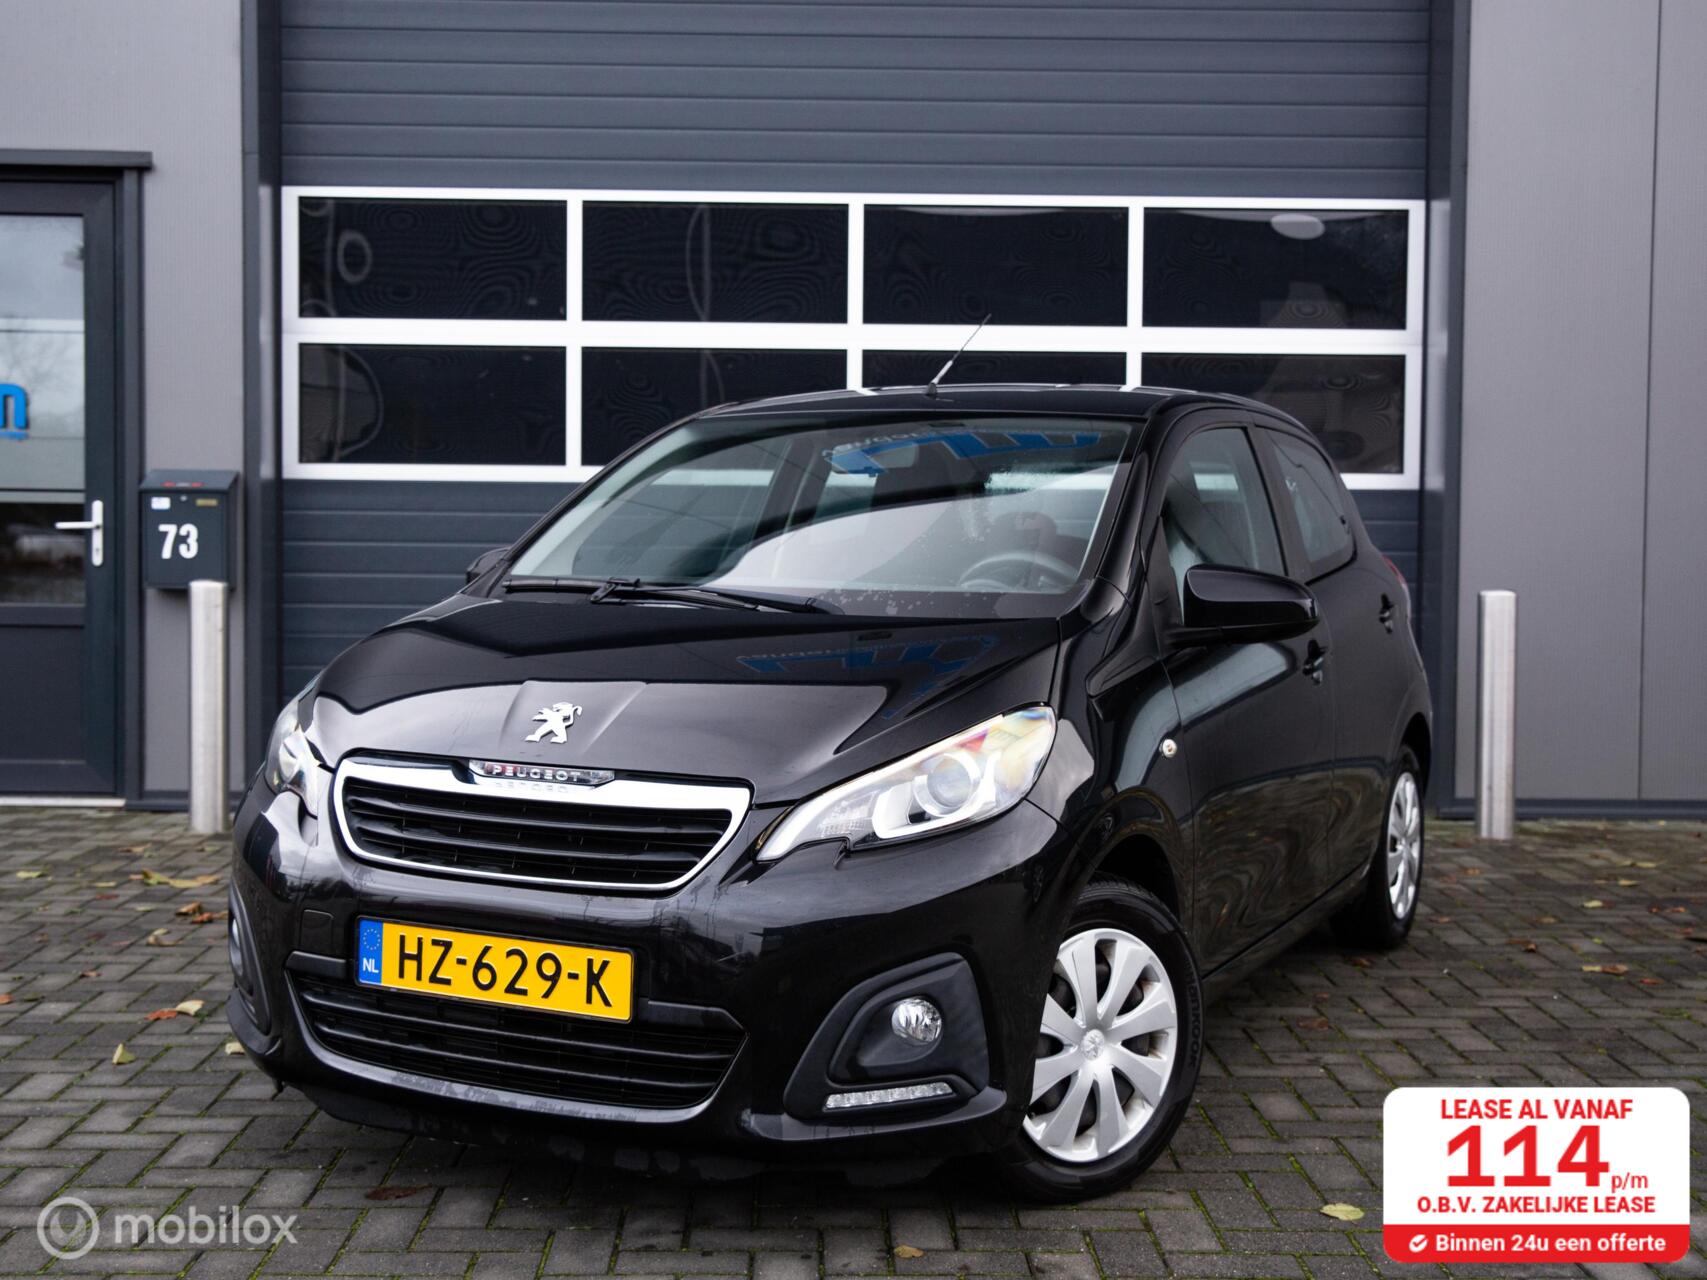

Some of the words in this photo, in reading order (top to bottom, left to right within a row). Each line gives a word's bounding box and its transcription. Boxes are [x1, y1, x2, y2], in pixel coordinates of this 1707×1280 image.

[158, 523, 199, 560] 73
[491, 765, 582, 782] PEUGEOT
[361, 957, 380, 975] NL
[397, 933, 613, 1008] HZ-629-K
